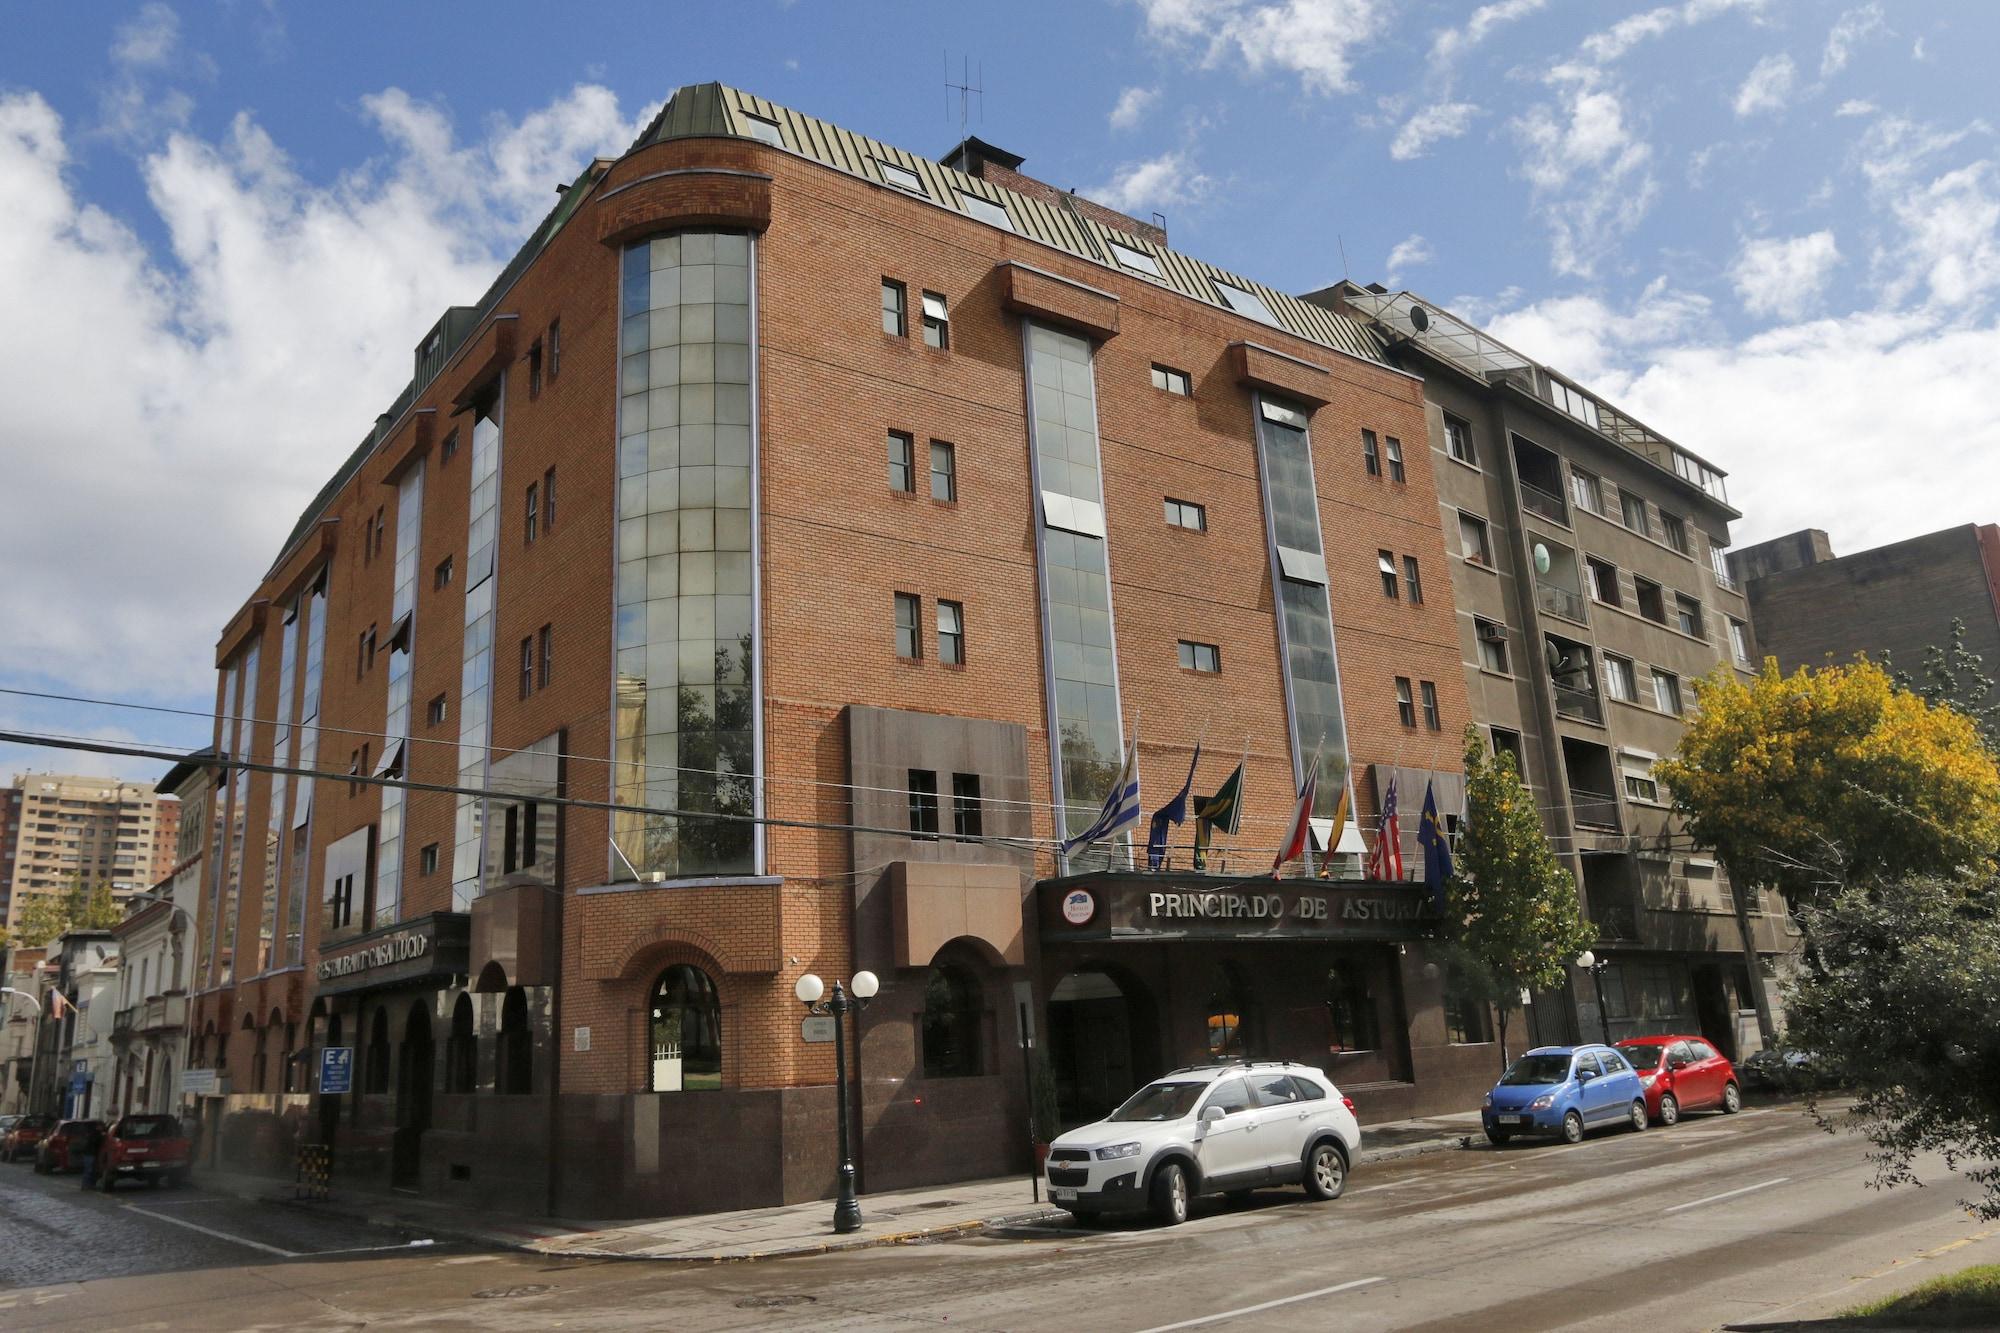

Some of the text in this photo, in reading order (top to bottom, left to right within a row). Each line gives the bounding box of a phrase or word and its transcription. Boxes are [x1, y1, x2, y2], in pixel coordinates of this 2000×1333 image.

[1149, 893, 1284, 918] PRINCIPADO
[1299, 896, 1328, 920] DE
[316, 950, 367, 980] RESTAURANT
[325, 1050, 337, 1065] E
